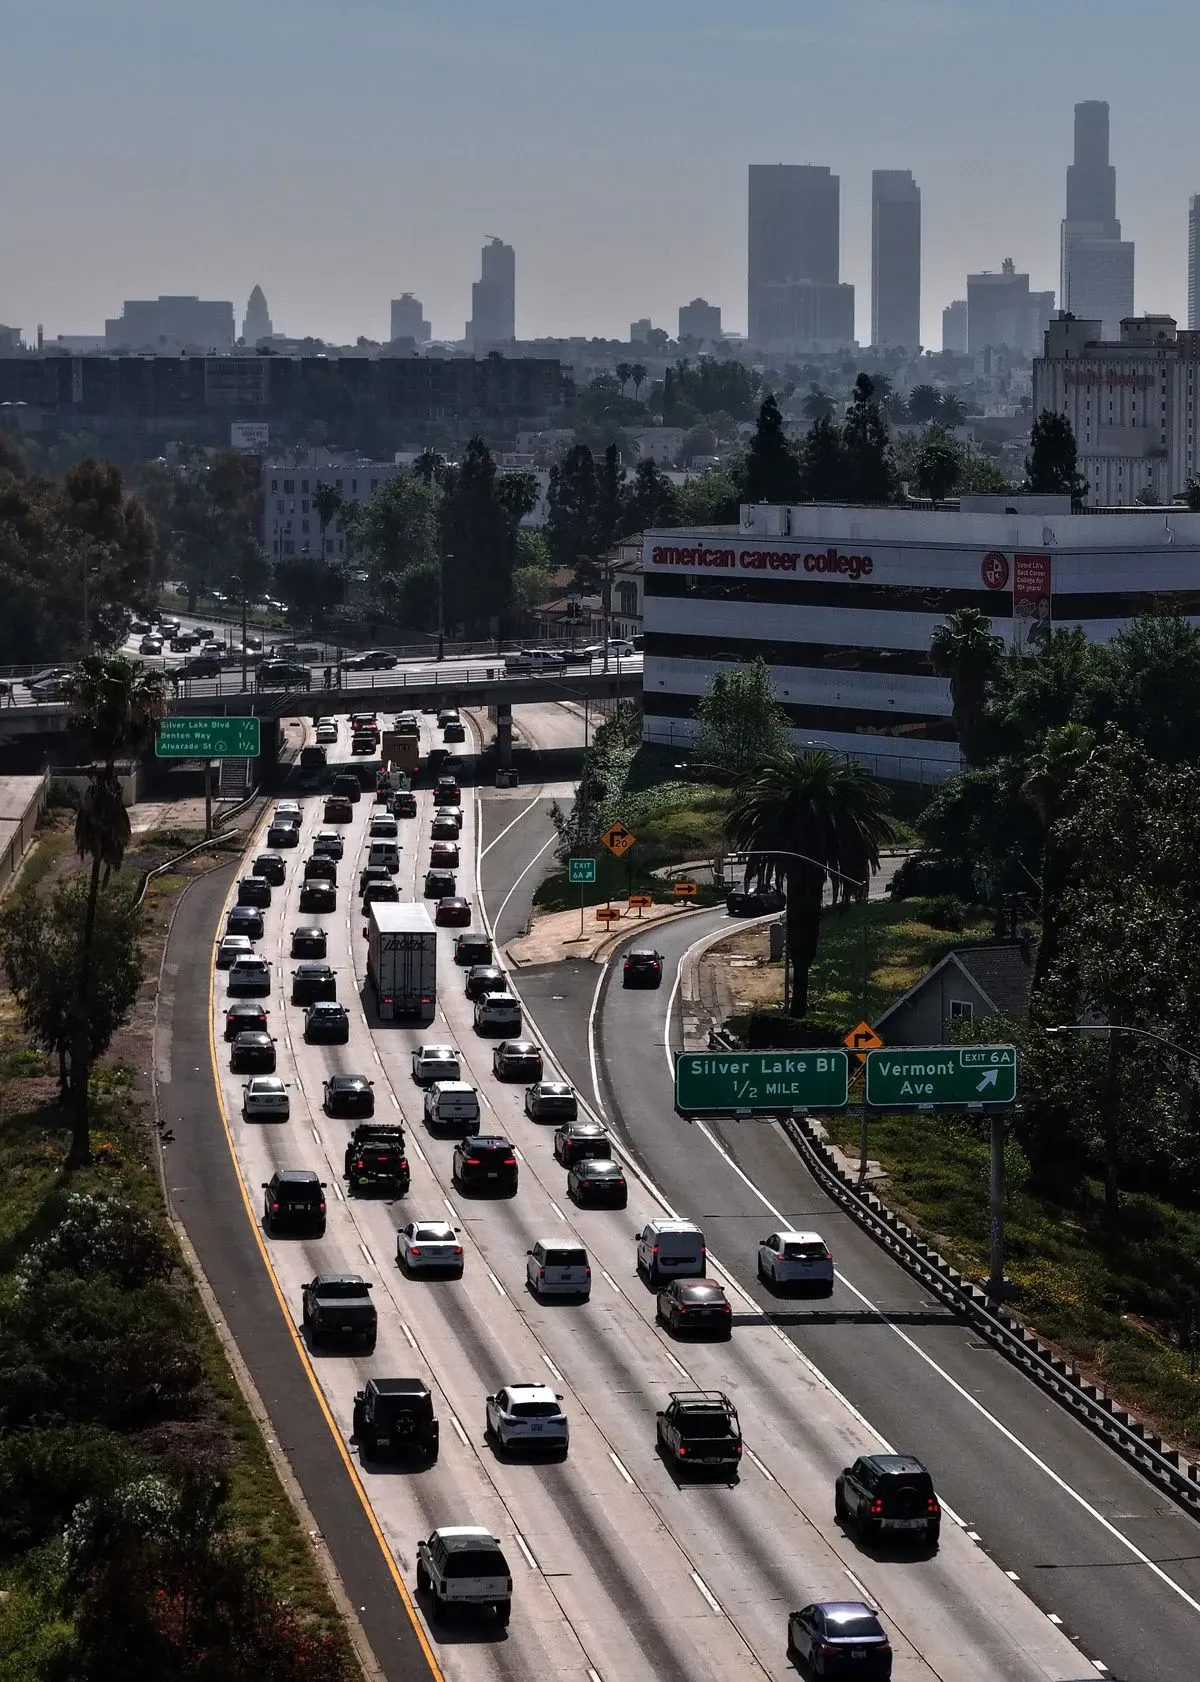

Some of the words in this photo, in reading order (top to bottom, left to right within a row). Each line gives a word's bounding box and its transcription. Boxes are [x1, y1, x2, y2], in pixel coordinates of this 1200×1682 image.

[652, 543, 736, 568] american
[739, 550, 801, 571] career
[803, 548, 874, 580] college
[160, 721, 186, 729] Silver
[188, 721, 208, 729] Lake
[211, 721, 230, 729] Blvd
[194, 732, 211, 740] Way
[615, 839, 628, 848] 20
[572, 871, 584, 879] 6A
[965, 1053, 985, 1062] EXIT
[990, 1052, 1011, 1063] 6A
[690, 1060, 750, 1075] Silver
[761, 1059, 807, 1074] Lake
[816, 1058, 836, 1072] Bl
[878, 1061, 955, 1076] Vermont
[766, 1082, 800, 1094] MILE
[900, 1081, 934, 1095] Ave
